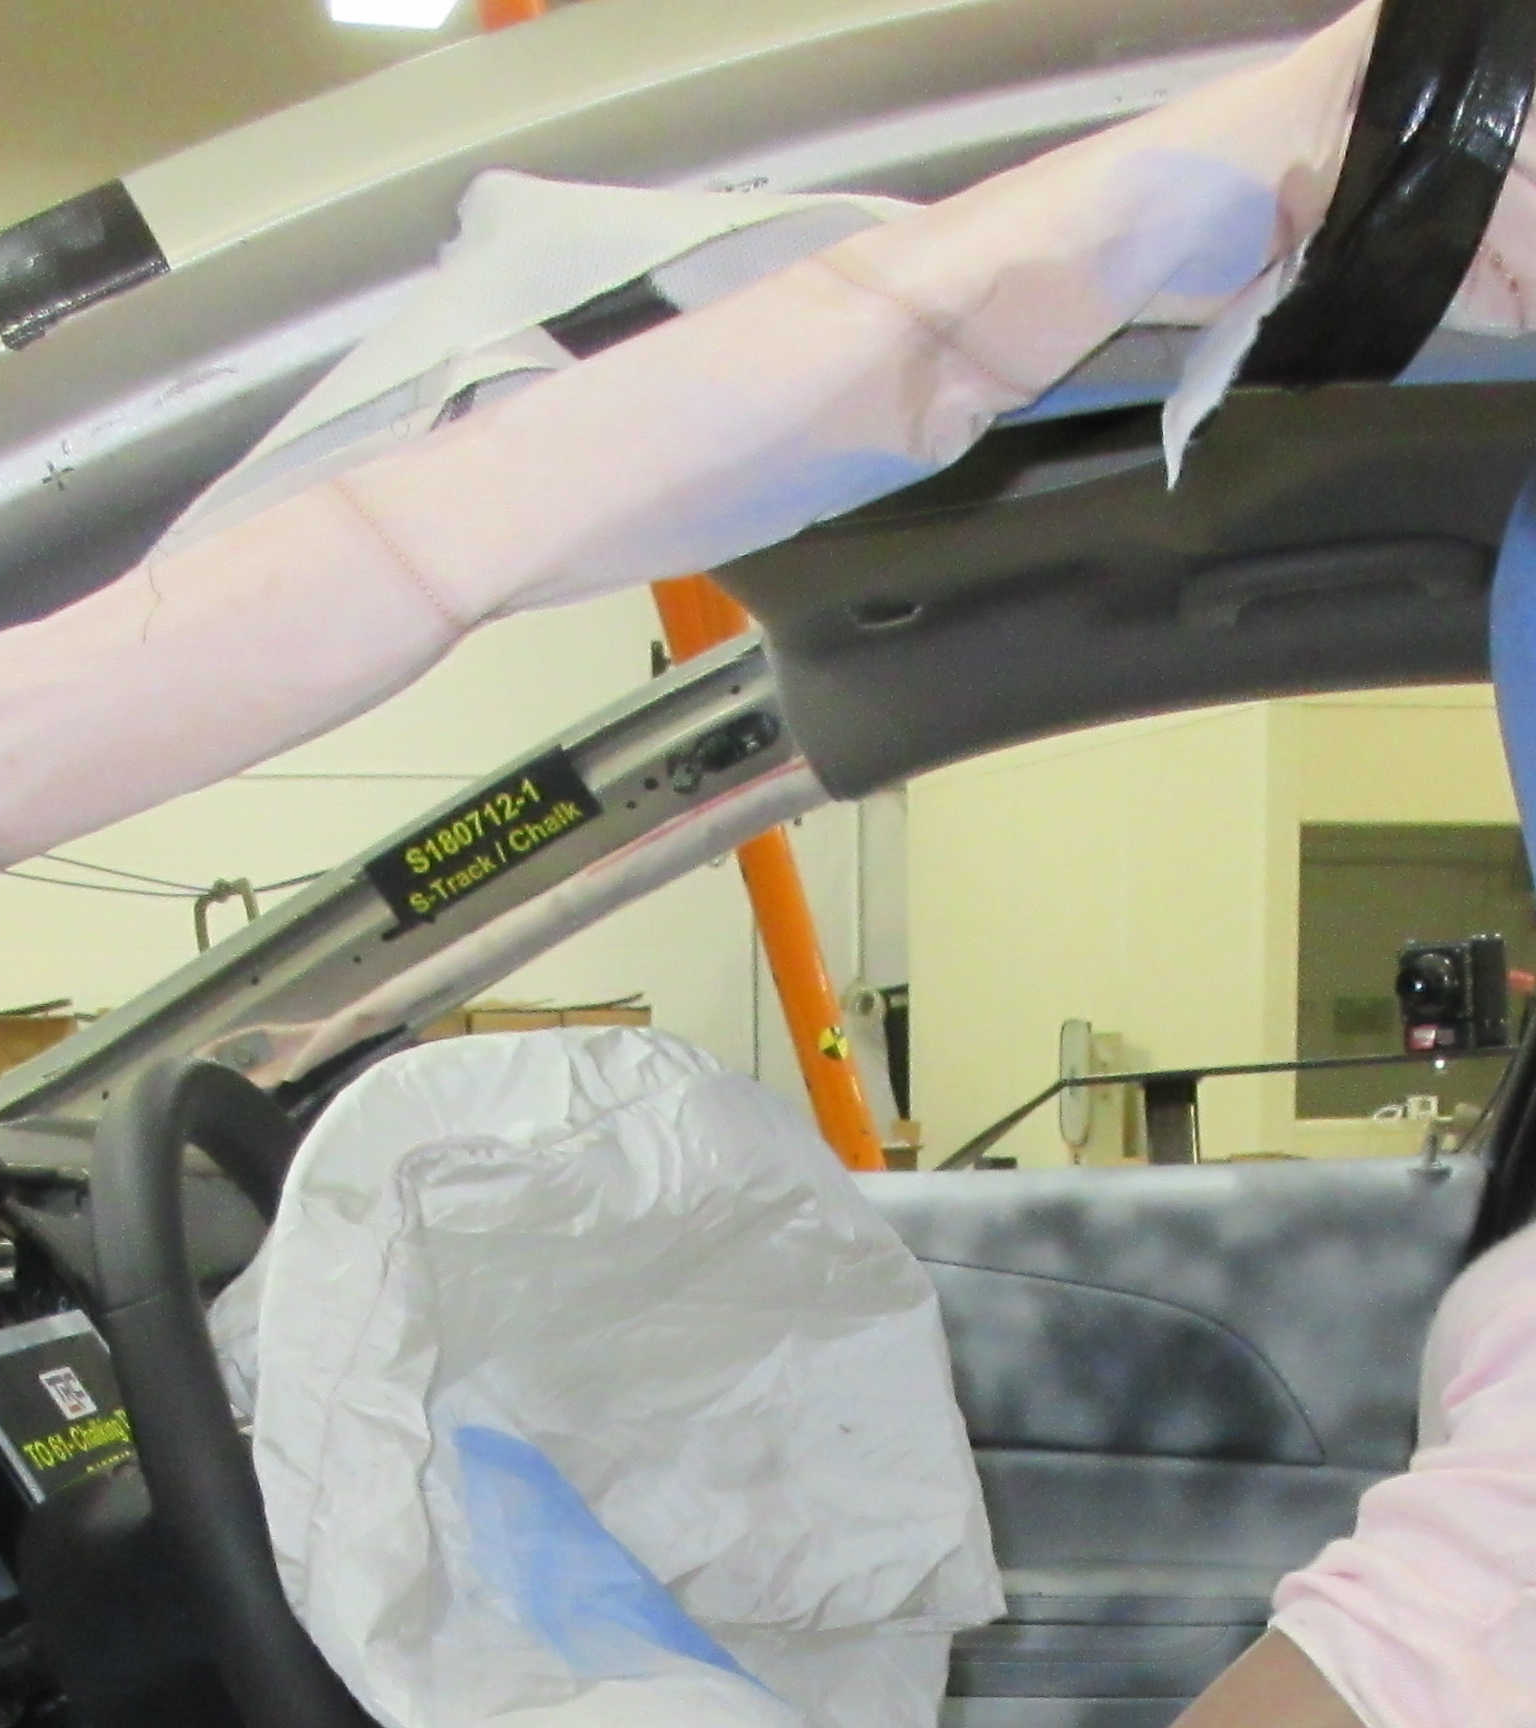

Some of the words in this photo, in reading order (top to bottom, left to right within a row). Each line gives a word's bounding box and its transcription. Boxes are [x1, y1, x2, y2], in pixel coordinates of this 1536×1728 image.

[405, 778, 541, 873] S180712-1
[409, 855, 497, 913] S-Track
[508, 801, 583, 851] Chalk
[23, 1441, 54, 1470] TO
